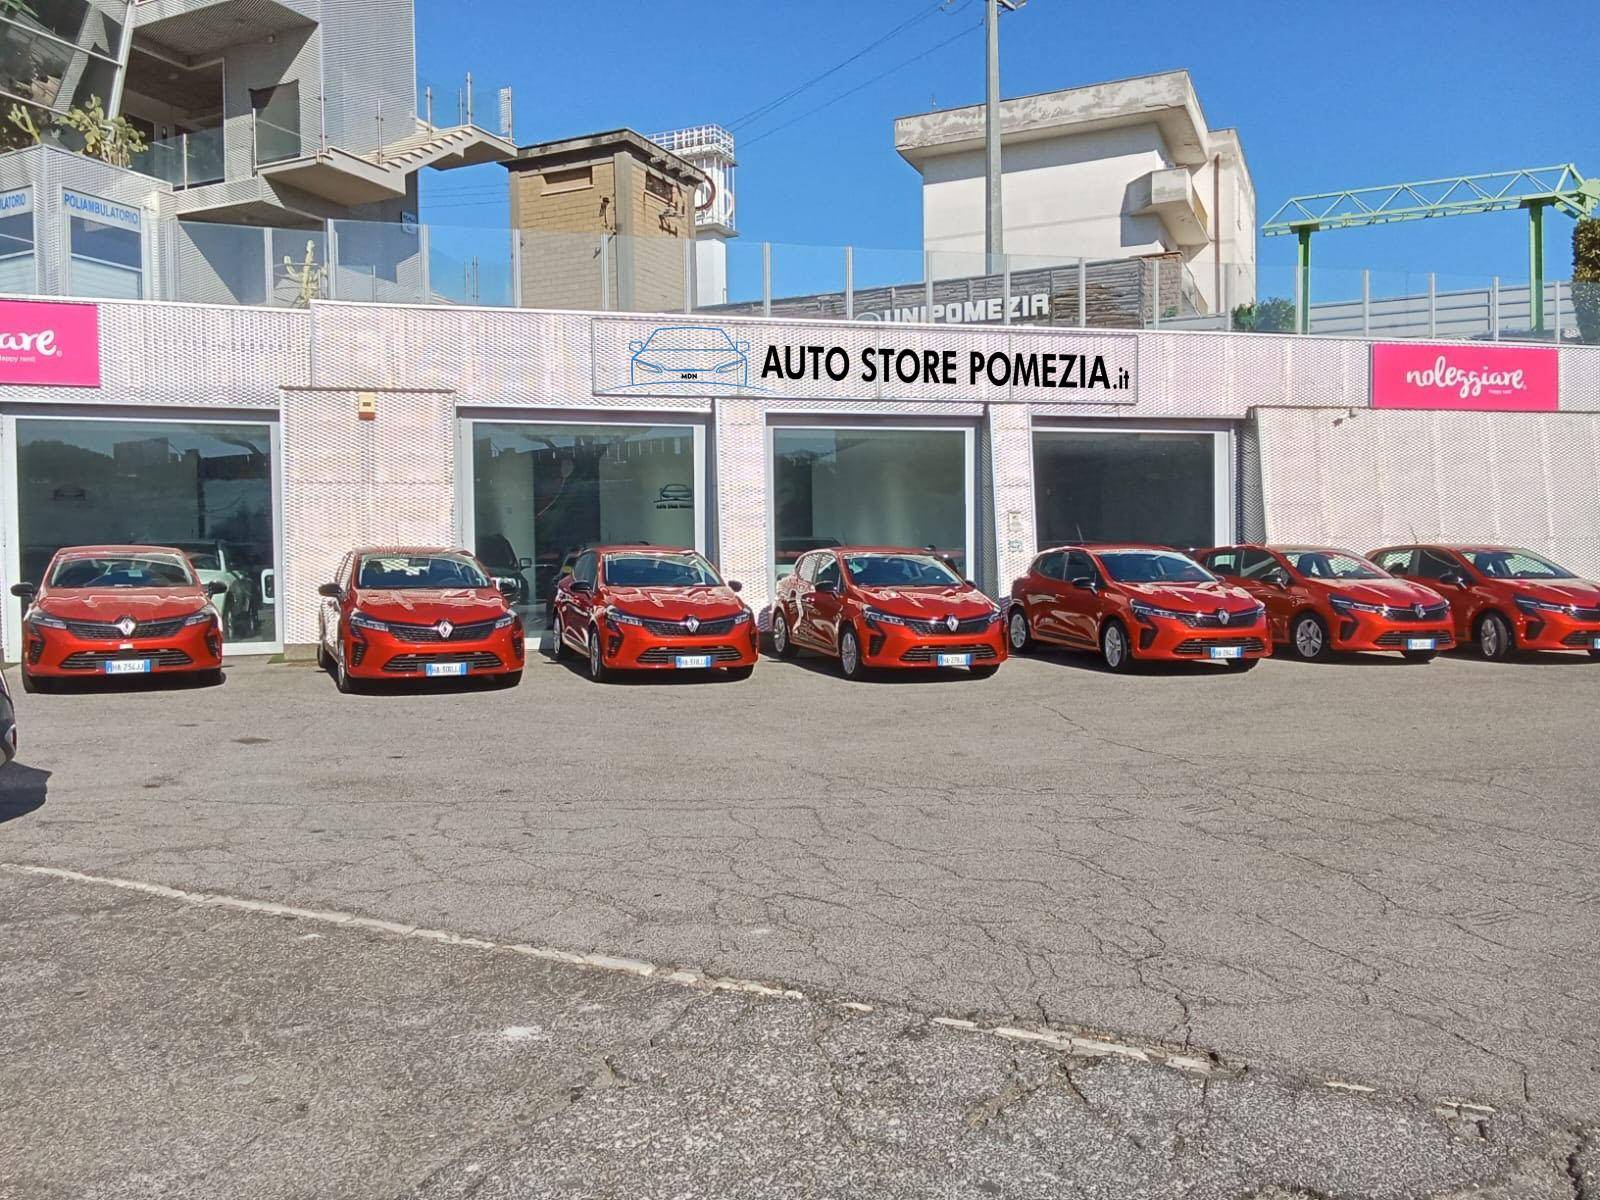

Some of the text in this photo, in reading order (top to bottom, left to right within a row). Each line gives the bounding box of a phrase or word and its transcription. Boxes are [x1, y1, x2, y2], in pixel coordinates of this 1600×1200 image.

[0, 193, 26, 210] LATORIO
[64, 193, 138, 223] POLIAMBULATORIO
[884, 293, 1050, 322] UNIPOMEZIA
[761, 345, 850, 381] AUTO
[861, 347, 957, 384] STORE
[1406, 355, 1525, 398] noleggiare
